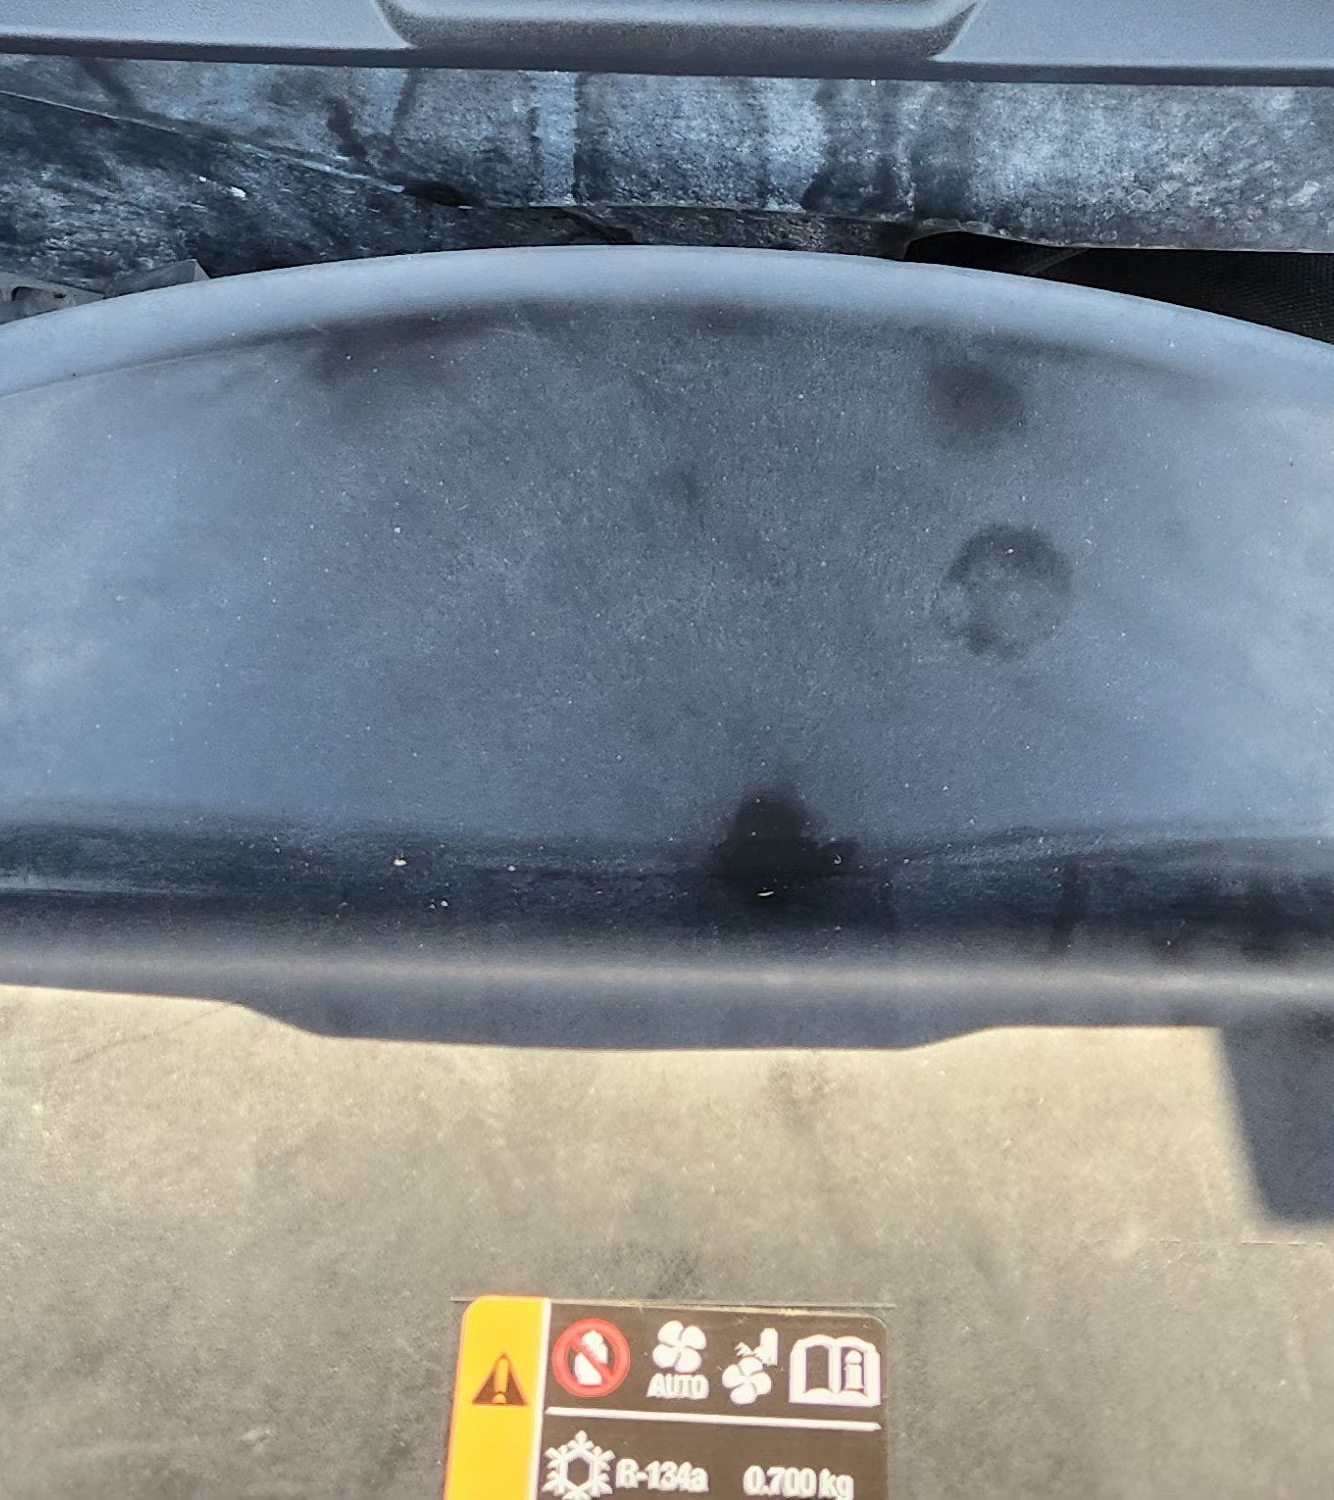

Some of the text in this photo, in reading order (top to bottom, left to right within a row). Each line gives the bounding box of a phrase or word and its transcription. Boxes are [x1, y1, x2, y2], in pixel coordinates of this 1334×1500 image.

[646, 1373, 709, 1400] AUTO
[617, 1458, 855, 1500] R-134a 0.700 kg
